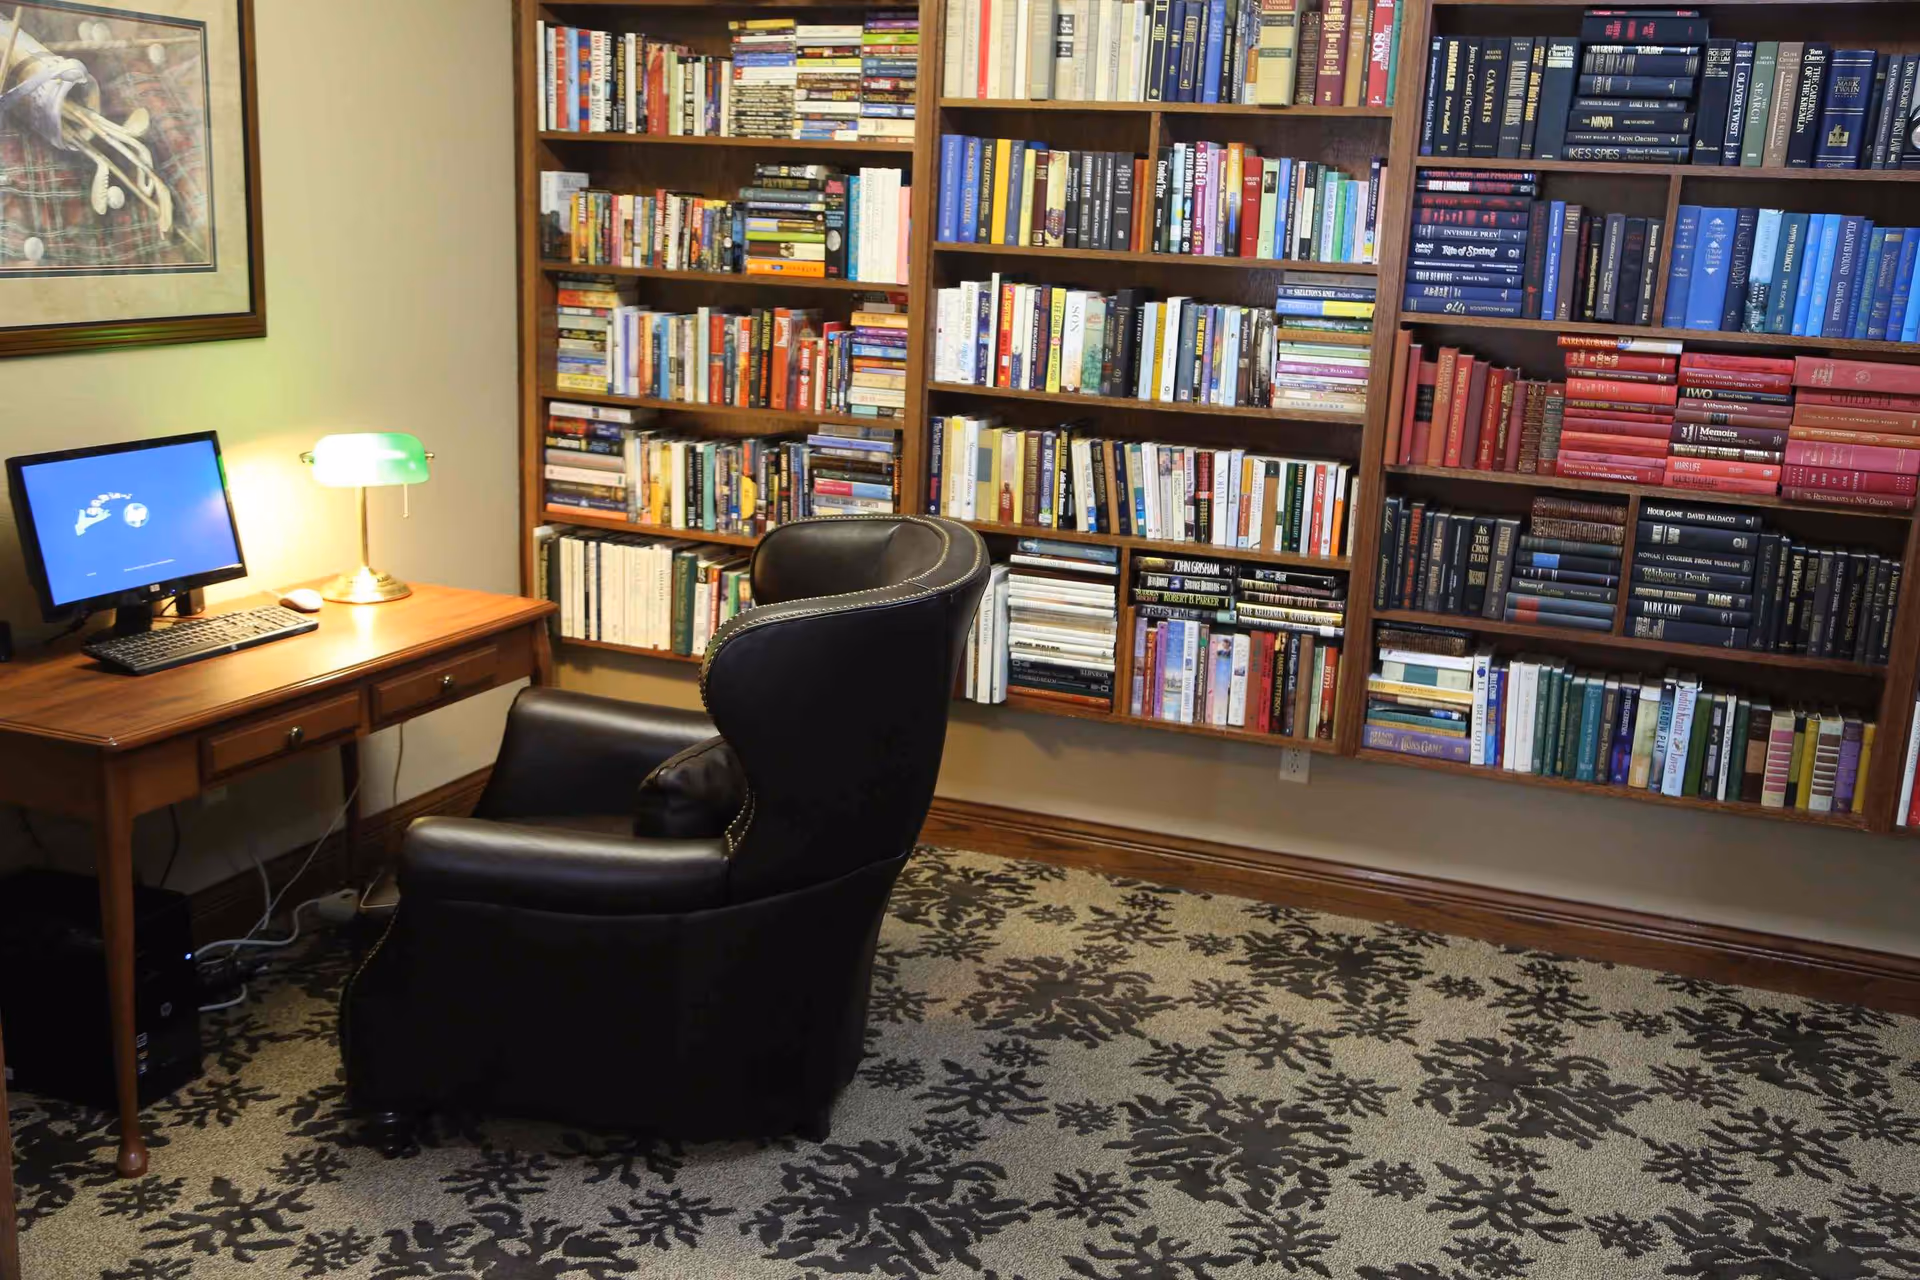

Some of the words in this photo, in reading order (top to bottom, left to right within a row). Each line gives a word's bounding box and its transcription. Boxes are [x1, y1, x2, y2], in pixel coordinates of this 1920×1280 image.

[1371, 32, 1386, 62] SON
[1445, 41, 1460, 91] HIMMLER
[1808, 65, 1816, 75] OF
[1814, 65, 1825, 82] THE
[1732, 72, 1746, 107] OLIVER
[1806, 77, 1815, 93] THE
[1482, 69, 1497, 124] CANARIS
[1750, 82, 1765, 125] SEARCH
[1809, 83, 1822, 120] CARDINAL
[1800, 94, 1813, 130] KREMLIN
[1590, 116, 1614, 129] NINJA
[1729, 108, 1742, 137] TWIST
[1156, 160, 1168, 184] Crooked
[1195, 152, 1207, 186] SHRED
[1155, 184, 1166, 198] Tree
[1443, 229, 1478, 237] INVISIBLE
[1480, 231, 1499, 239] PREY
[1843, 221, 1858, 252] ATLANTIS
[1441, 244, 1457, 255] Rite
[1466, 245, 1498, 258] Spring
[1839, 252, 1851, 275] FOUND
[1836, 281, 1847, 297] CLIVE
[1053, 301, 1061, 314] LEE
[1052, 314, 1061, 335] CHILD
[1135, 311, 1143, 342] INFERNO
[1197, 318, 1206, 330] THE
[1195, 331, 1205, 356] KEEPER
[1241, 339, 1249, 352] train
[1686, 387, 1713, 399] IWO
[1700, 426, 1738, 438] Memoirs
[1646, 506, 1665, 517] HOUR
[1665, 508, 1683, 518] GAME
[1686, 512, 1706, 520] DAVID
[1706, 514, 1736, 524] BALDACCI
[1477, 525, 1488, 535] AS
[1474, 535, 1490, 544] THE
[1471, 544, 1490, 554] CROW
[1470, 554, 1488, 563] FLIES
[1173, 560, 1191, 573] JOHN
[1191, 561, 1219, 577] GRISHAM
[1642, 567, 1676, 578] Without
[1685, 572, 1711, 583] Doubt
[1163, 592, 1189, 603] ROBERT
[1196, 594, 1219, 607] PARKER
[1143, 606, 1175, 617] TRUST
[1178, 607, 1194, 618] ME
[1643, 601, 1663, 614] DARK
[1664, 603, 1683, 617] LADY
[1277, 653, 1285, 675] JAMES
[1322, 666, 1332, 688] RUTH
[1273, 676, 1283, 716] PATTERSON
[1677, 690, 1693, 712] Judith
[1475, 704, 1484, 726] BRET
[1658, 701, 1671, 733] SHADOW
[1673, 713, 1690, 736] Krantz
[1474, 730, 1483, 753] LOTT
[1655, 735, 1667, 753] PLAY
[1668, 753, 1683, 774] Lovers
